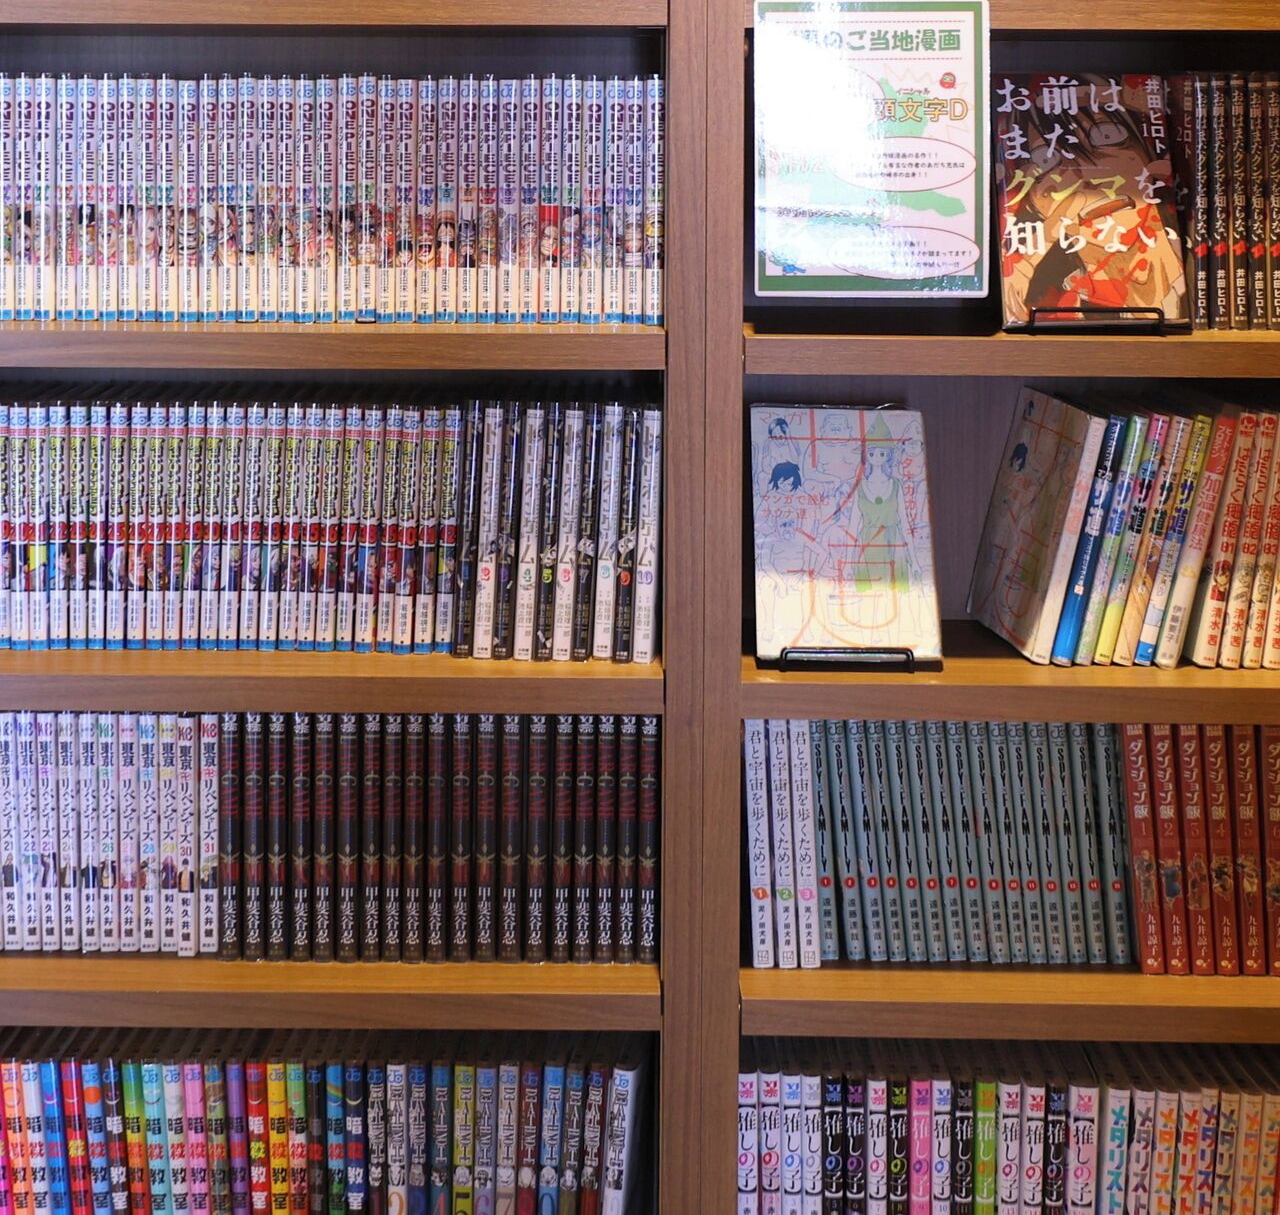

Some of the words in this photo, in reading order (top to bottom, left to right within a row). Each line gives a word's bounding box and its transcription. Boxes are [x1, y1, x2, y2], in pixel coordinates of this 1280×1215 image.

[996, 77, 1126, 115] お前は
[1145, 79, 1166, 153] 井田ヒロト
[1000, 123, 1078, 160] まだ
[1005, 168, 1165, 207] グンマを
[1004, 213, 1177, 256] 知らない
[1237, 268, 1246, 314] 井田ヒロト
[1189, 473, 1223, 551] 加温健康法
[1221, 543, 1234, 555] 01
[1243, 543, 1256, 555] 02
[523, 569, 532, 582] 4
[638, 571, 653, 584] 10
[1129, 740, 1149, 818] ダンジョン飯
[1156, 741, 1175, 818] ダンジョン飯
[749, 731, 766, 877] 君と宇宙を歩くために
[772, 731, 790, 878] 君と宇宙を歩くために
[180, 847, 191, 856] 30
[205, 844, 214, 853] 31
[26, 1117, 47, 1208] 暗殺教室
[1107, 1106, 1128, 1213] メダリスト
